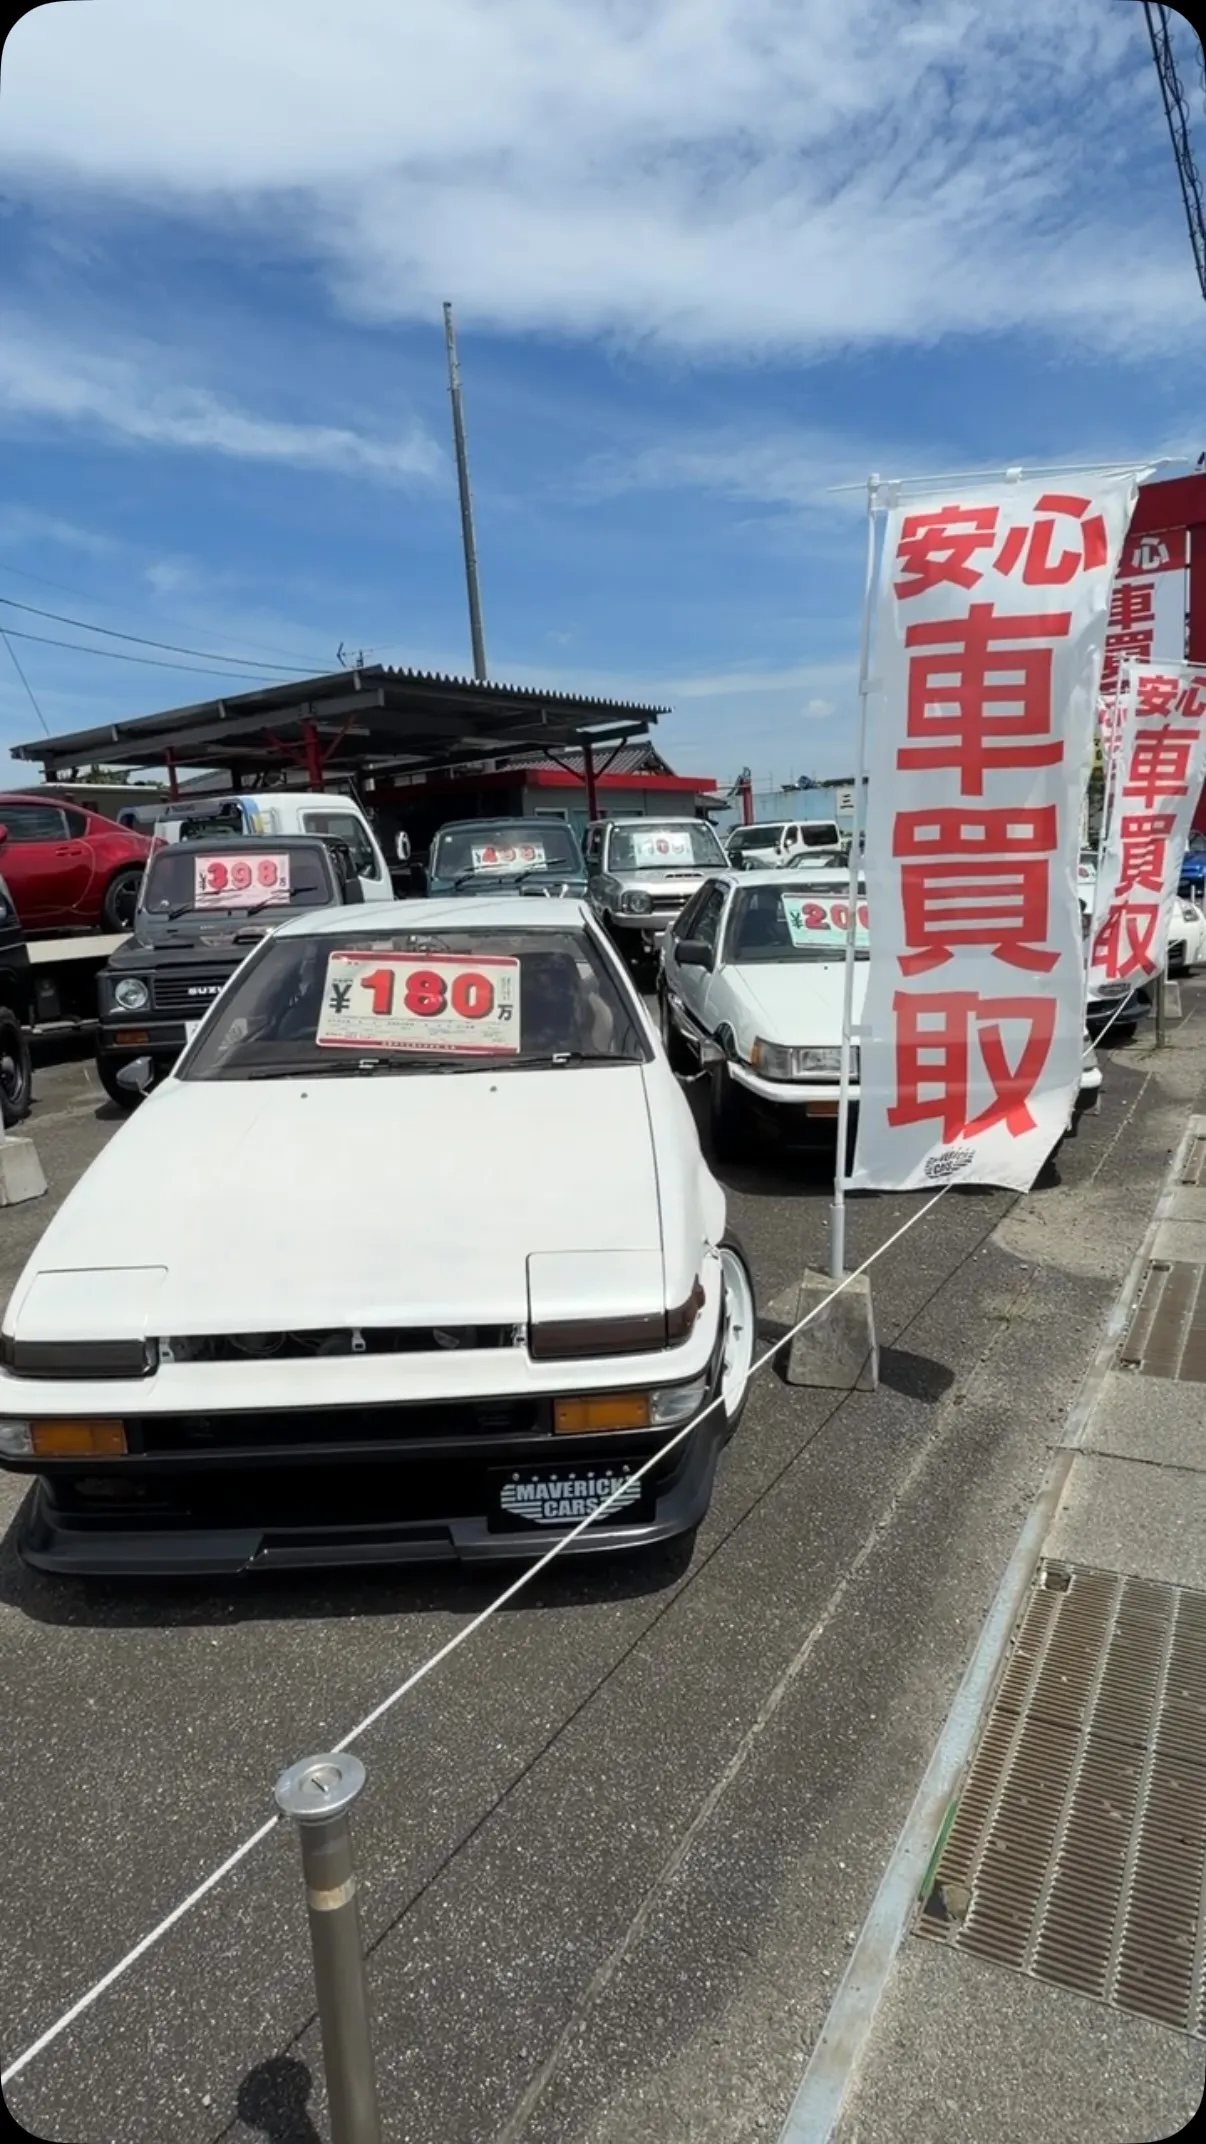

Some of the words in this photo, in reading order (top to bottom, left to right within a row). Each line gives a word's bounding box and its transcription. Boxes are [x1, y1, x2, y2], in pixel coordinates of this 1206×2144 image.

[893, 494, 1108, 600] 安心
[1135, 675, 1206, 717] 安心
[887, 602, 1072, 1144] 車買取
[1091, 723, 1201, 979] 車買取
[516, 1477, 627, 1501] MAVERICK
[543, 1498, 599, 1518] CARS
